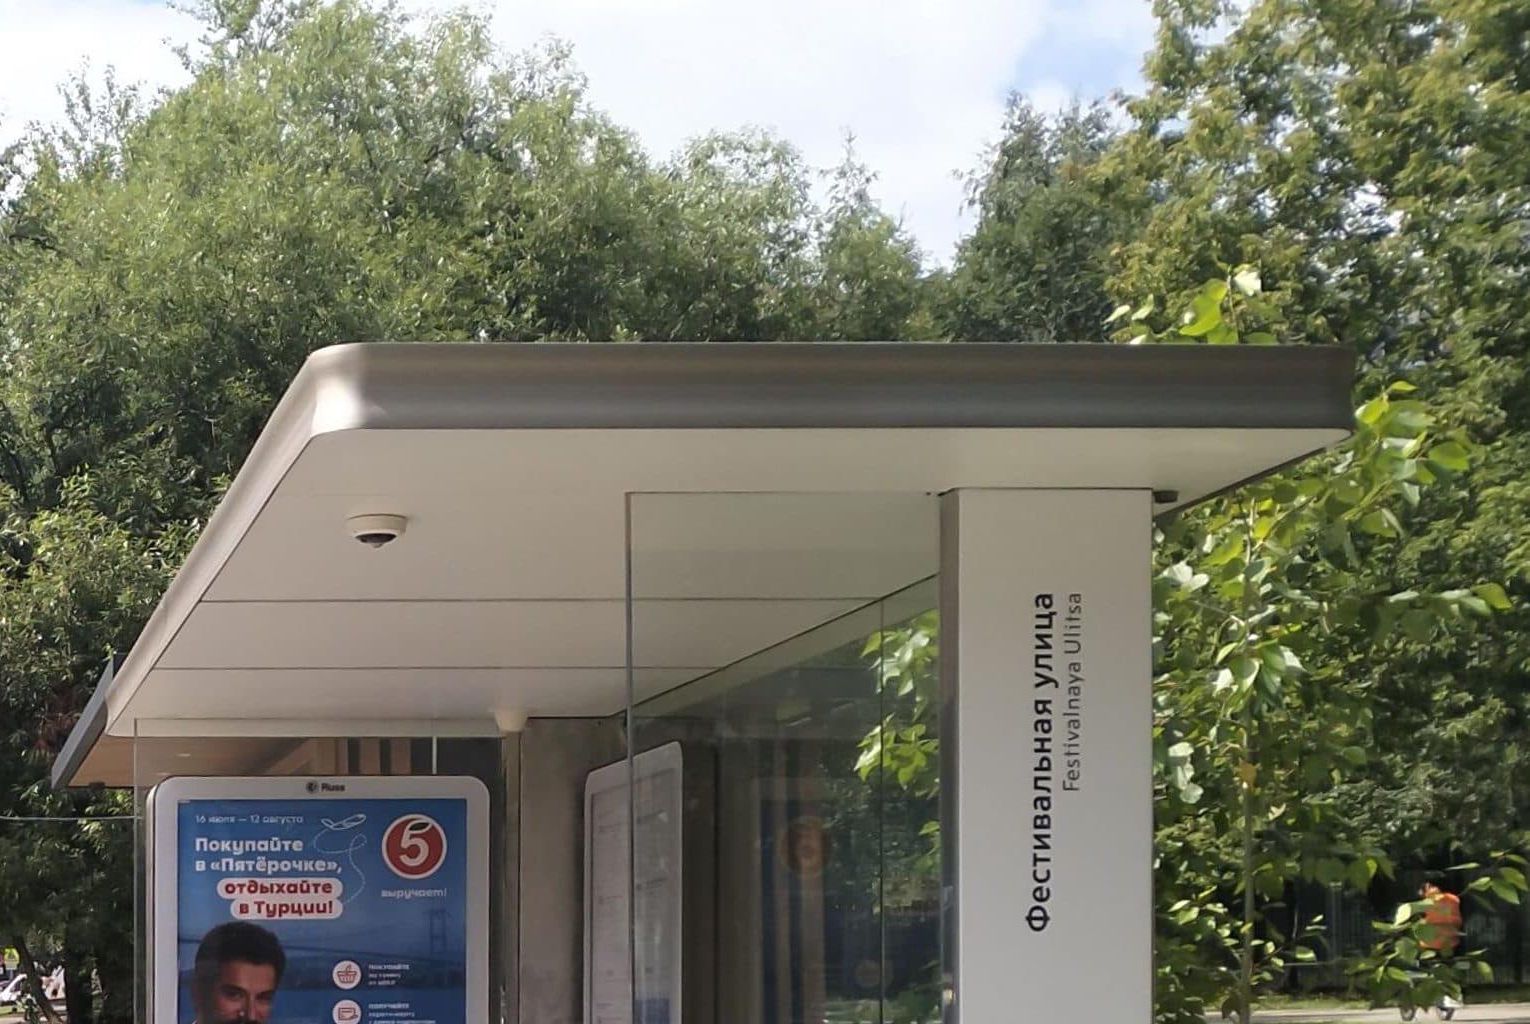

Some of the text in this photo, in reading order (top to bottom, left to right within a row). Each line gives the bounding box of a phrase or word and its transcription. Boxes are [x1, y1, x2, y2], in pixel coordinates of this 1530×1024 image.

[1063, 592, 1085, 792] Festivalnaya Ulitsa
[1025, 593, 1058, 932] Фестивальная улица
[195, 815, 206, 823] 16
[250, 815, 260, 823] 12
[195, 837, 304, 855] Покупайте
[195, 856, 342, 875] в «Пятёрочке»,
[224, 880, 333, 894] отдыхайте
[239, 901, 333, 918] в Турции!
